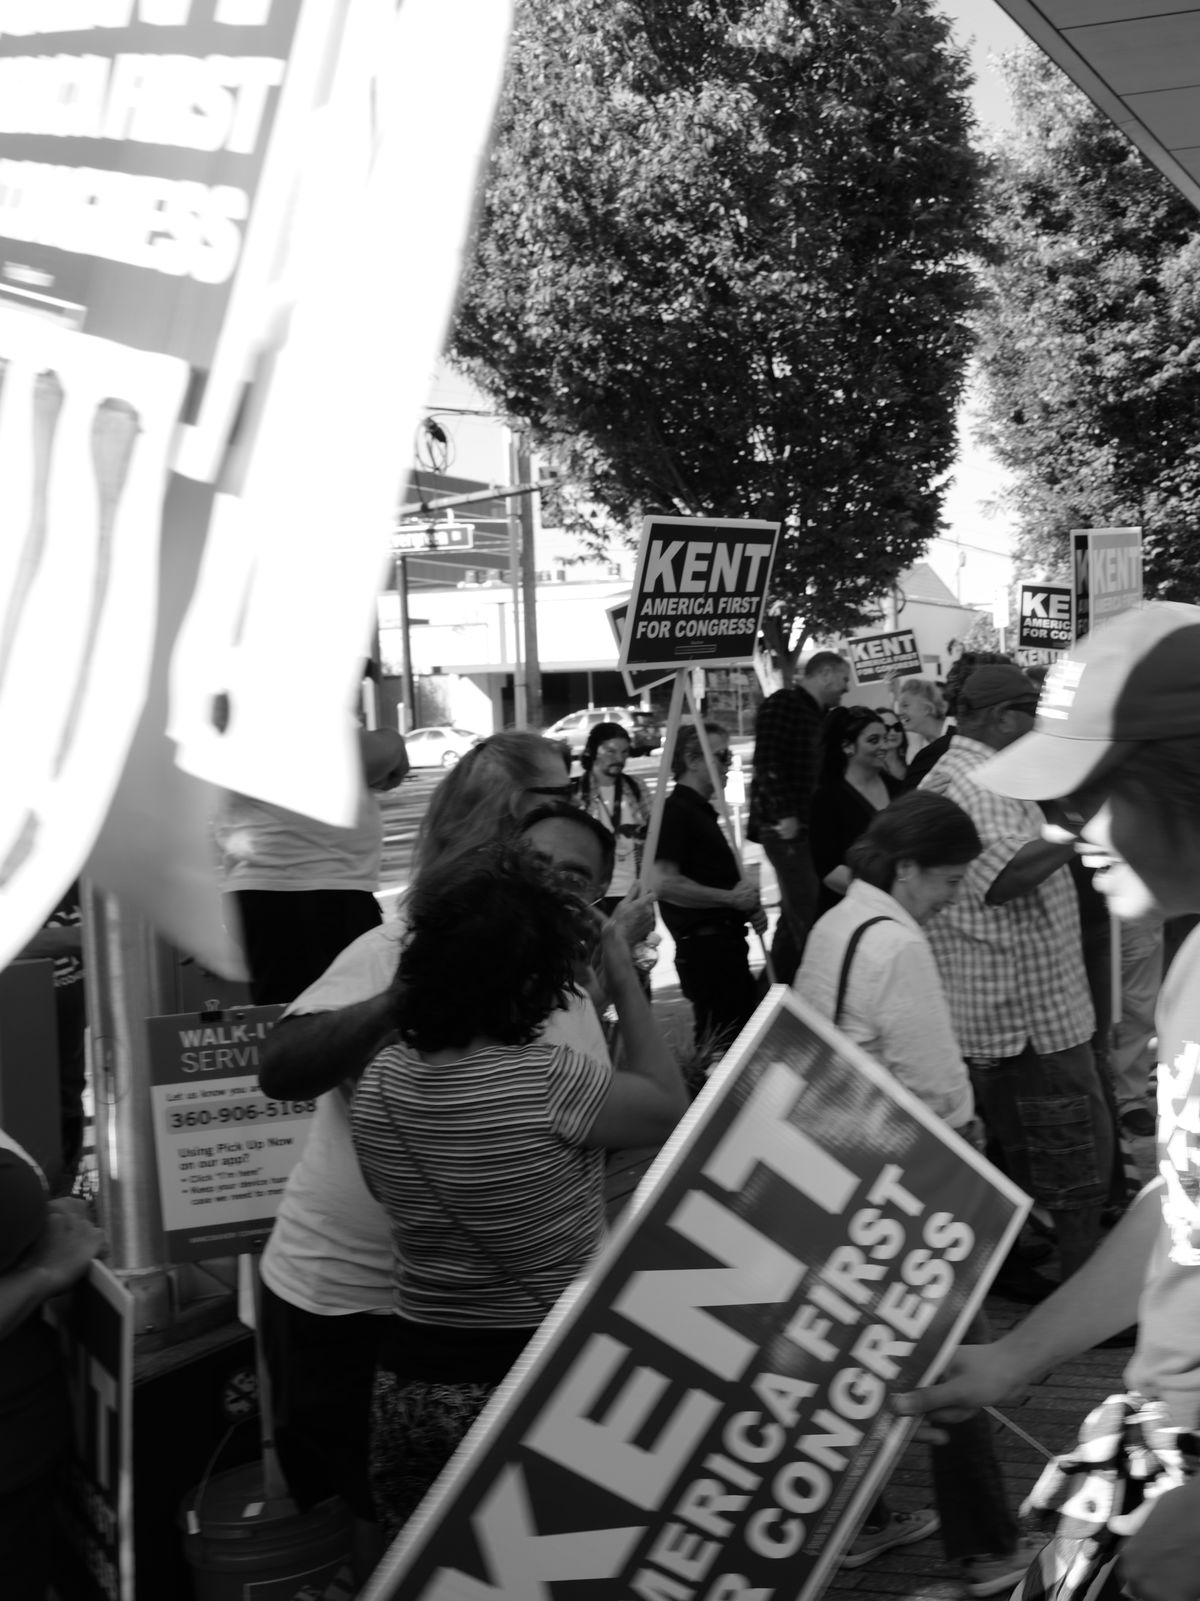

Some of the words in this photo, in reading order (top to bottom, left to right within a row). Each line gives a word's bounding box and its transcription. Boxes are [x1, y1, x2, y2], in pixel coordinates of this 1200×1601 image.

[643, 540, 772, 593] KENT
[1092, 547, 1139, 595] KENT
[640, 597, 714, 616] AMERICA
[717, 597, 760, 614] FIRST
[636, 620, 671, 639] FOR
[674, 618, 755, 638] CONGRESS
[1022, 627, 1048, 639] FOR
[850, 633, 914, 661] KENT
[170, 1100, 317, 1129] 360-906-5168
[178, 1147, 215, 1158] Using
[216, 1142, 243, 1153] Pick
[245, 1140, 265, 1150] Up
[267, 1137, 293, 1147] Now
[179, 1162, 195, 1170] on
[198, 1159, 218, 1168] our
[221, 1153, 250, 1167] app?
[784, 1163, 925, 1362] FIRST
[418, 1062, 861, 1601] KENT
[744, 1212, 975, 1559] CONGRESS
